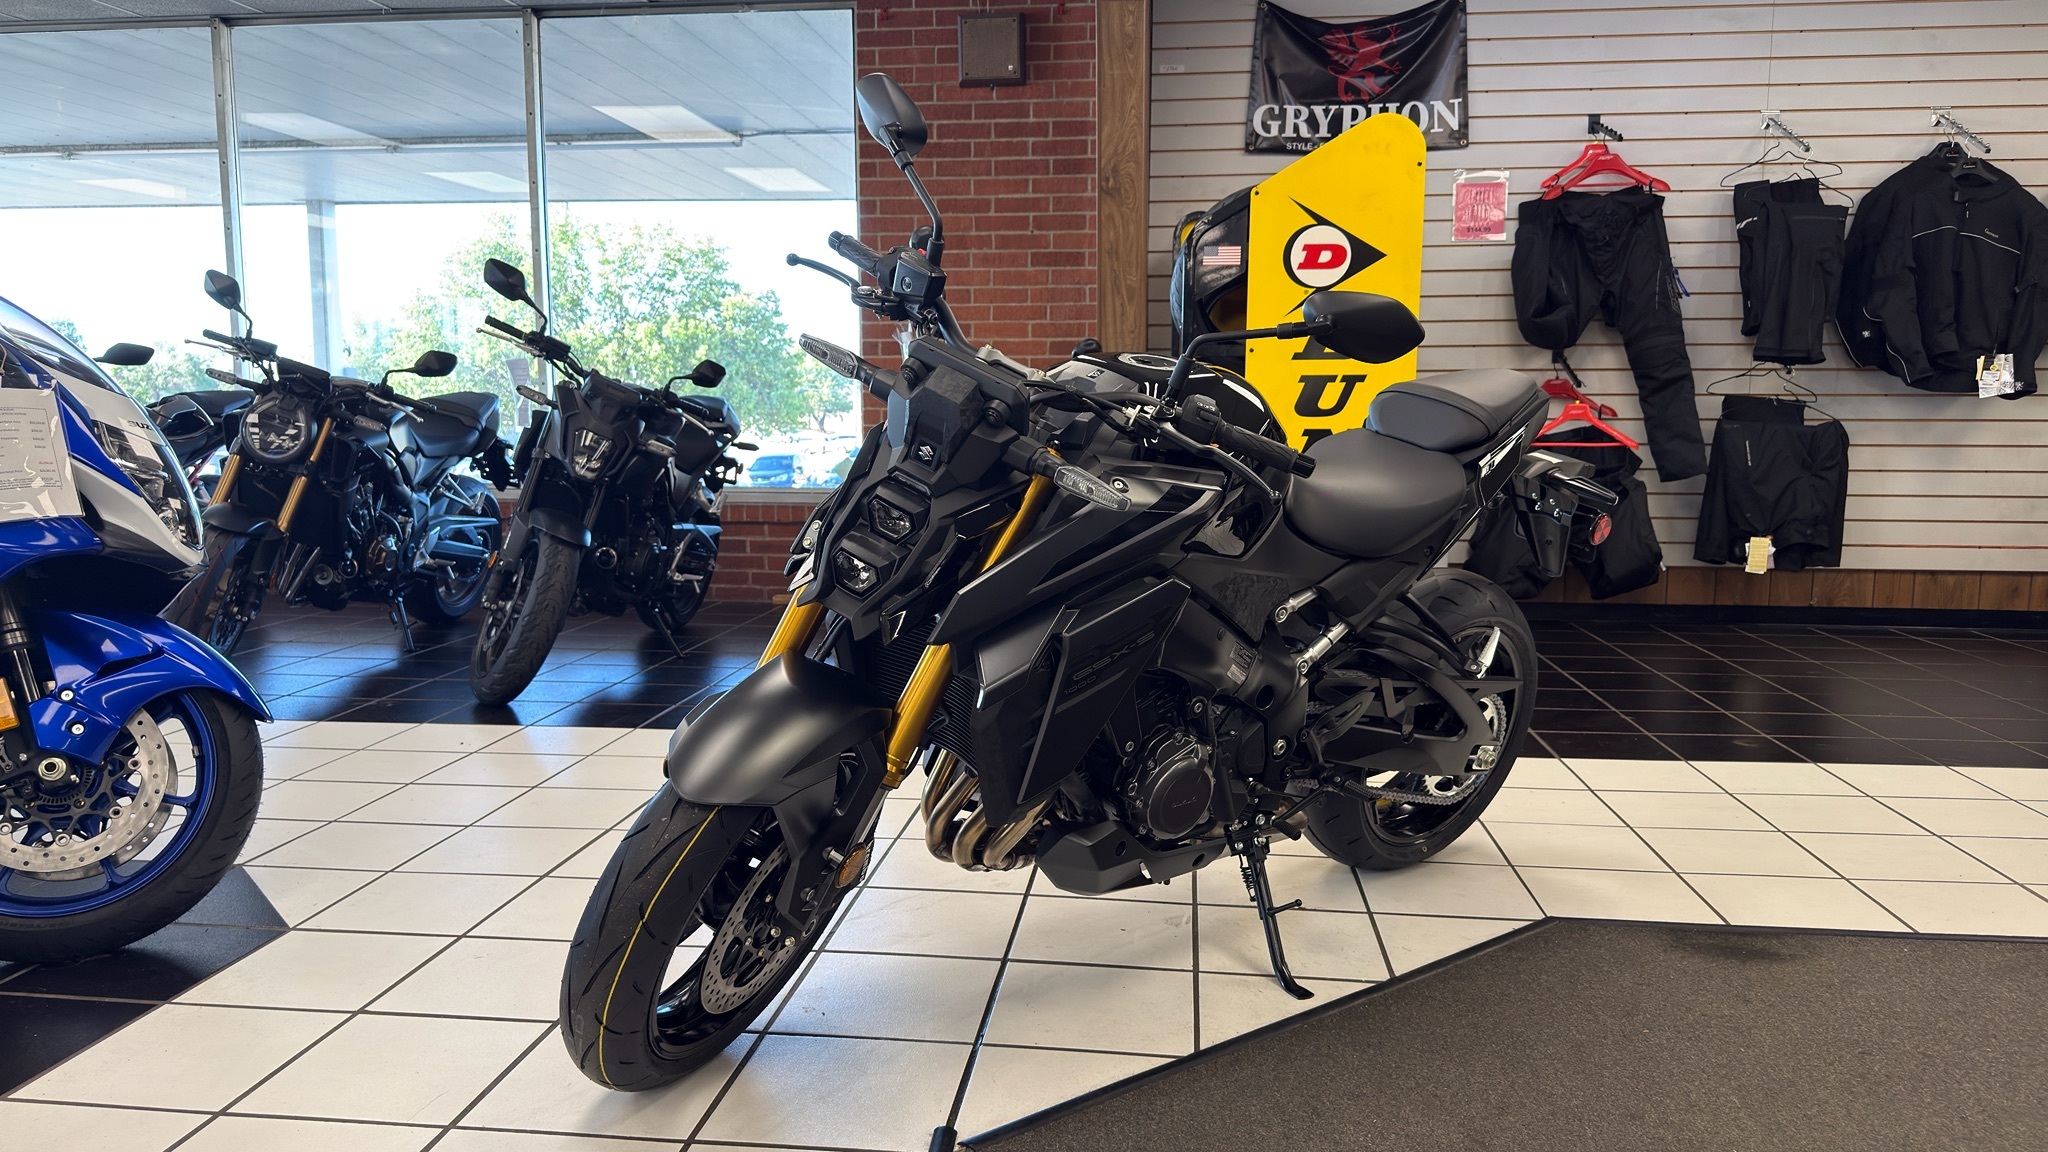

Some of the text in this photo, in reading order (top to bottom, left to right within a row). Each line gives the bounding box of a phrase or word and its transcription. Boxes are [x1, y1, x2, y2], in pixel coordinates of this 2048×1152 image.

[1253, 98, 1462, 138] GRYPON
[1286, 142, 1313, 151] STYLE
[1296, 243, 1348, 270] D
[1073, 631, 1155, 680] GSX-S
[1064, 675, 1096, 695] 1000
